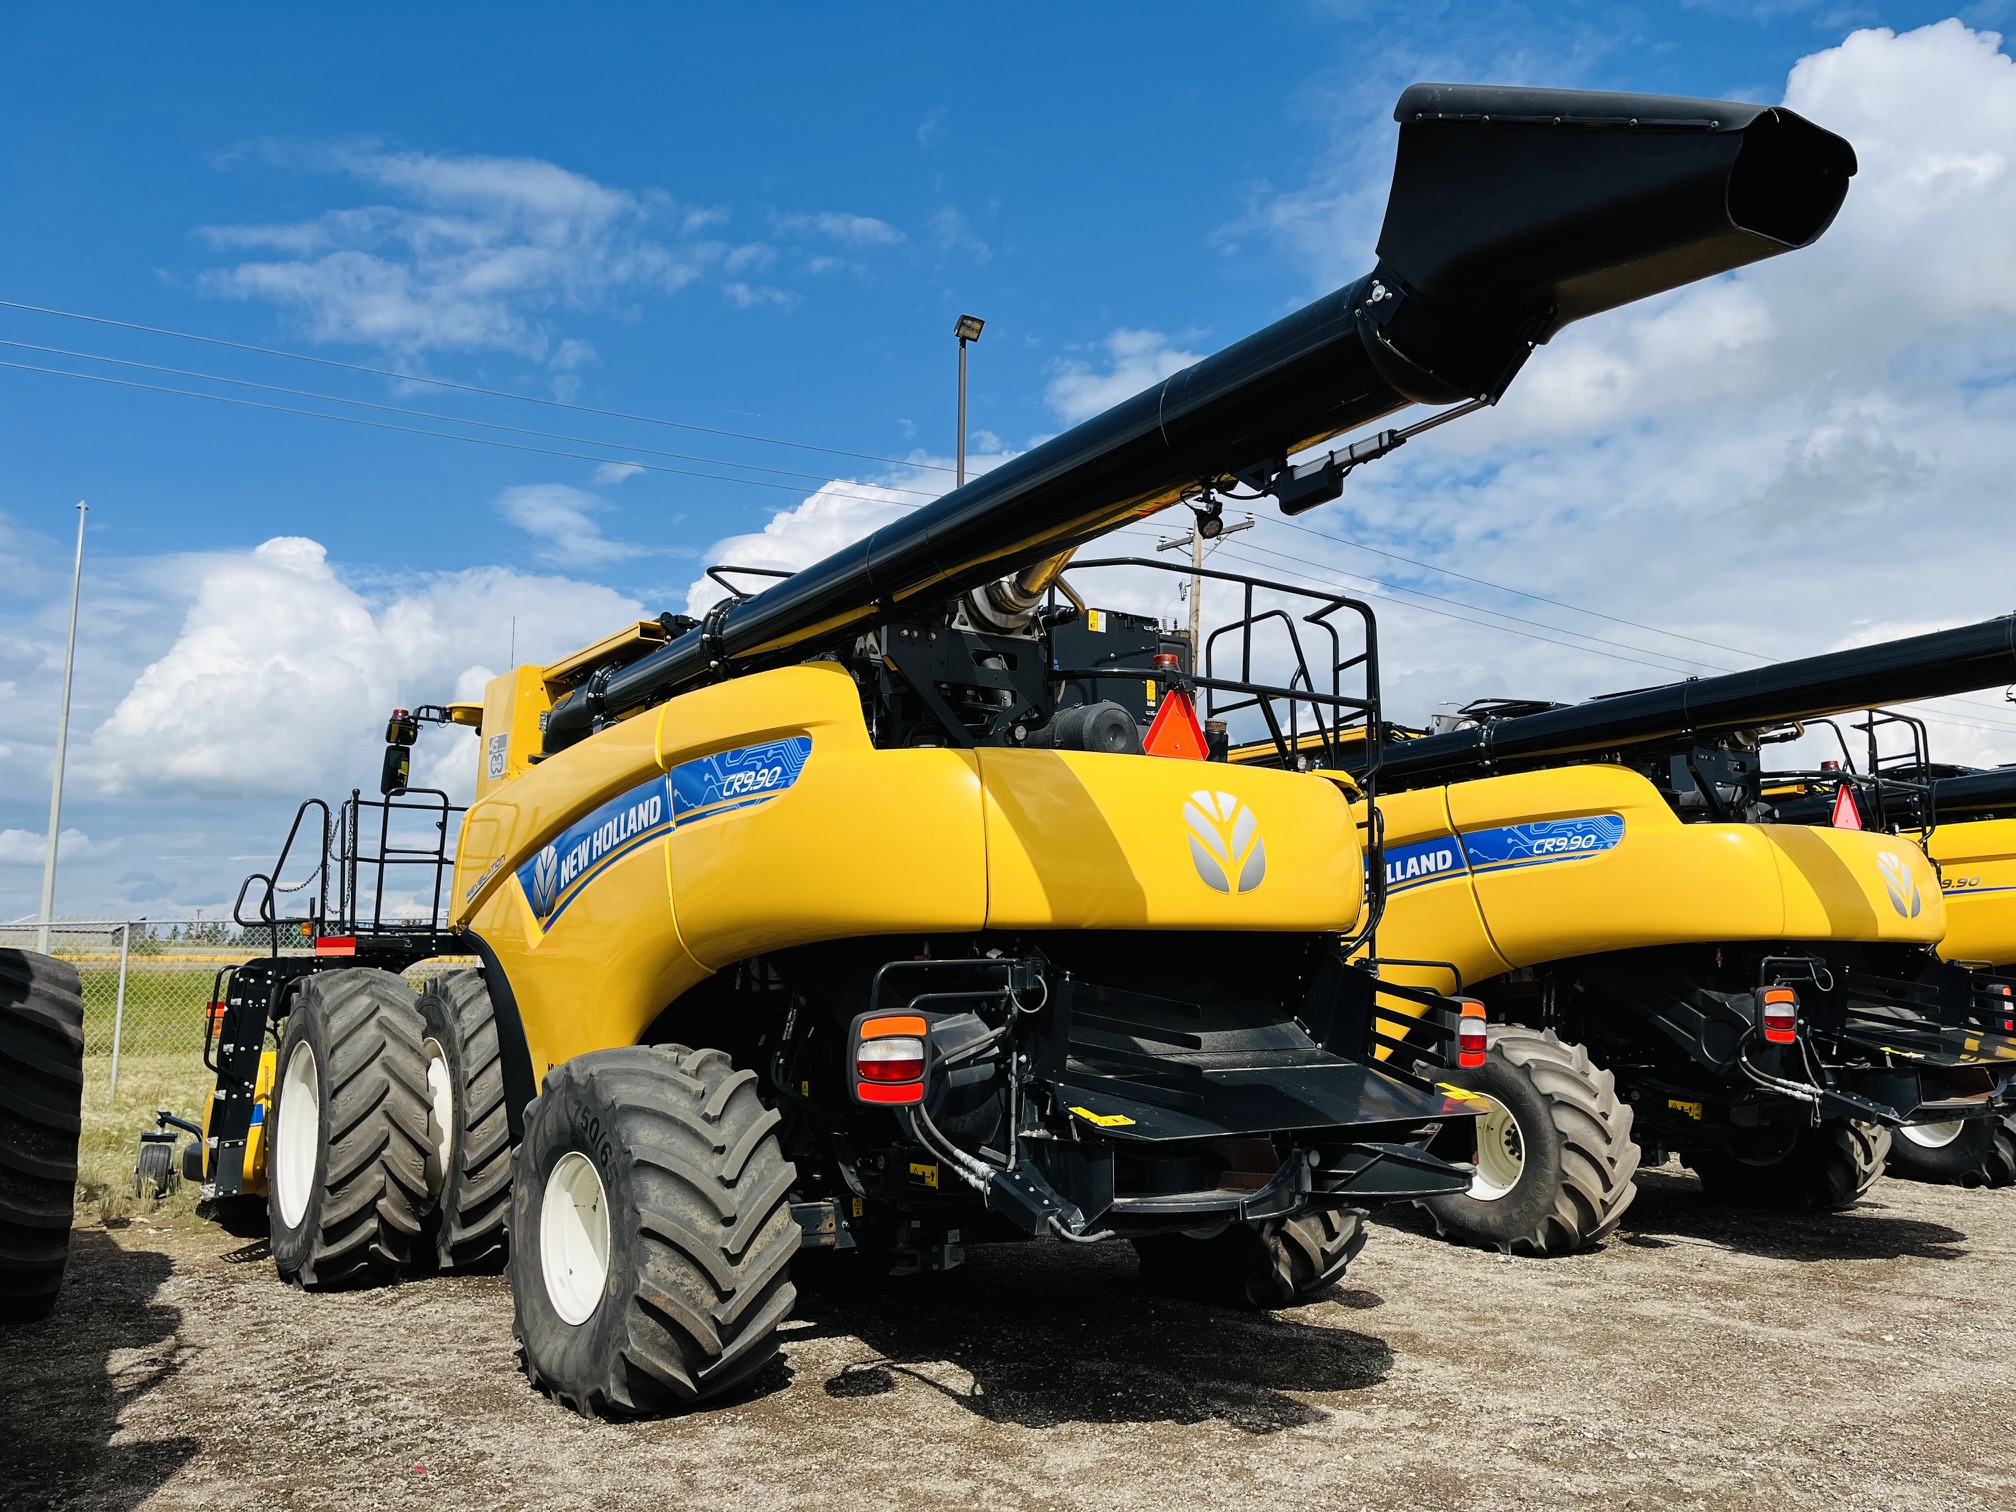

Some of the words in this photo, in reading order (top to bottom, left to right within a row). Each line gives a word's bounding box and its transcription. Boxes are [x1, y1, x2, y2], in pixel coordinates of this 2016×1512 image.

[722, 766, 782, 797] CR9.90
[560, 836, 591, 889] NEW
[592, 795, 662, 860] HOLLAND
[1533, 834, 1596, 854] CR9.90
[1365, 849, 1453, 893] LLAND
[571, 1098, 619, 1188] 750/65
